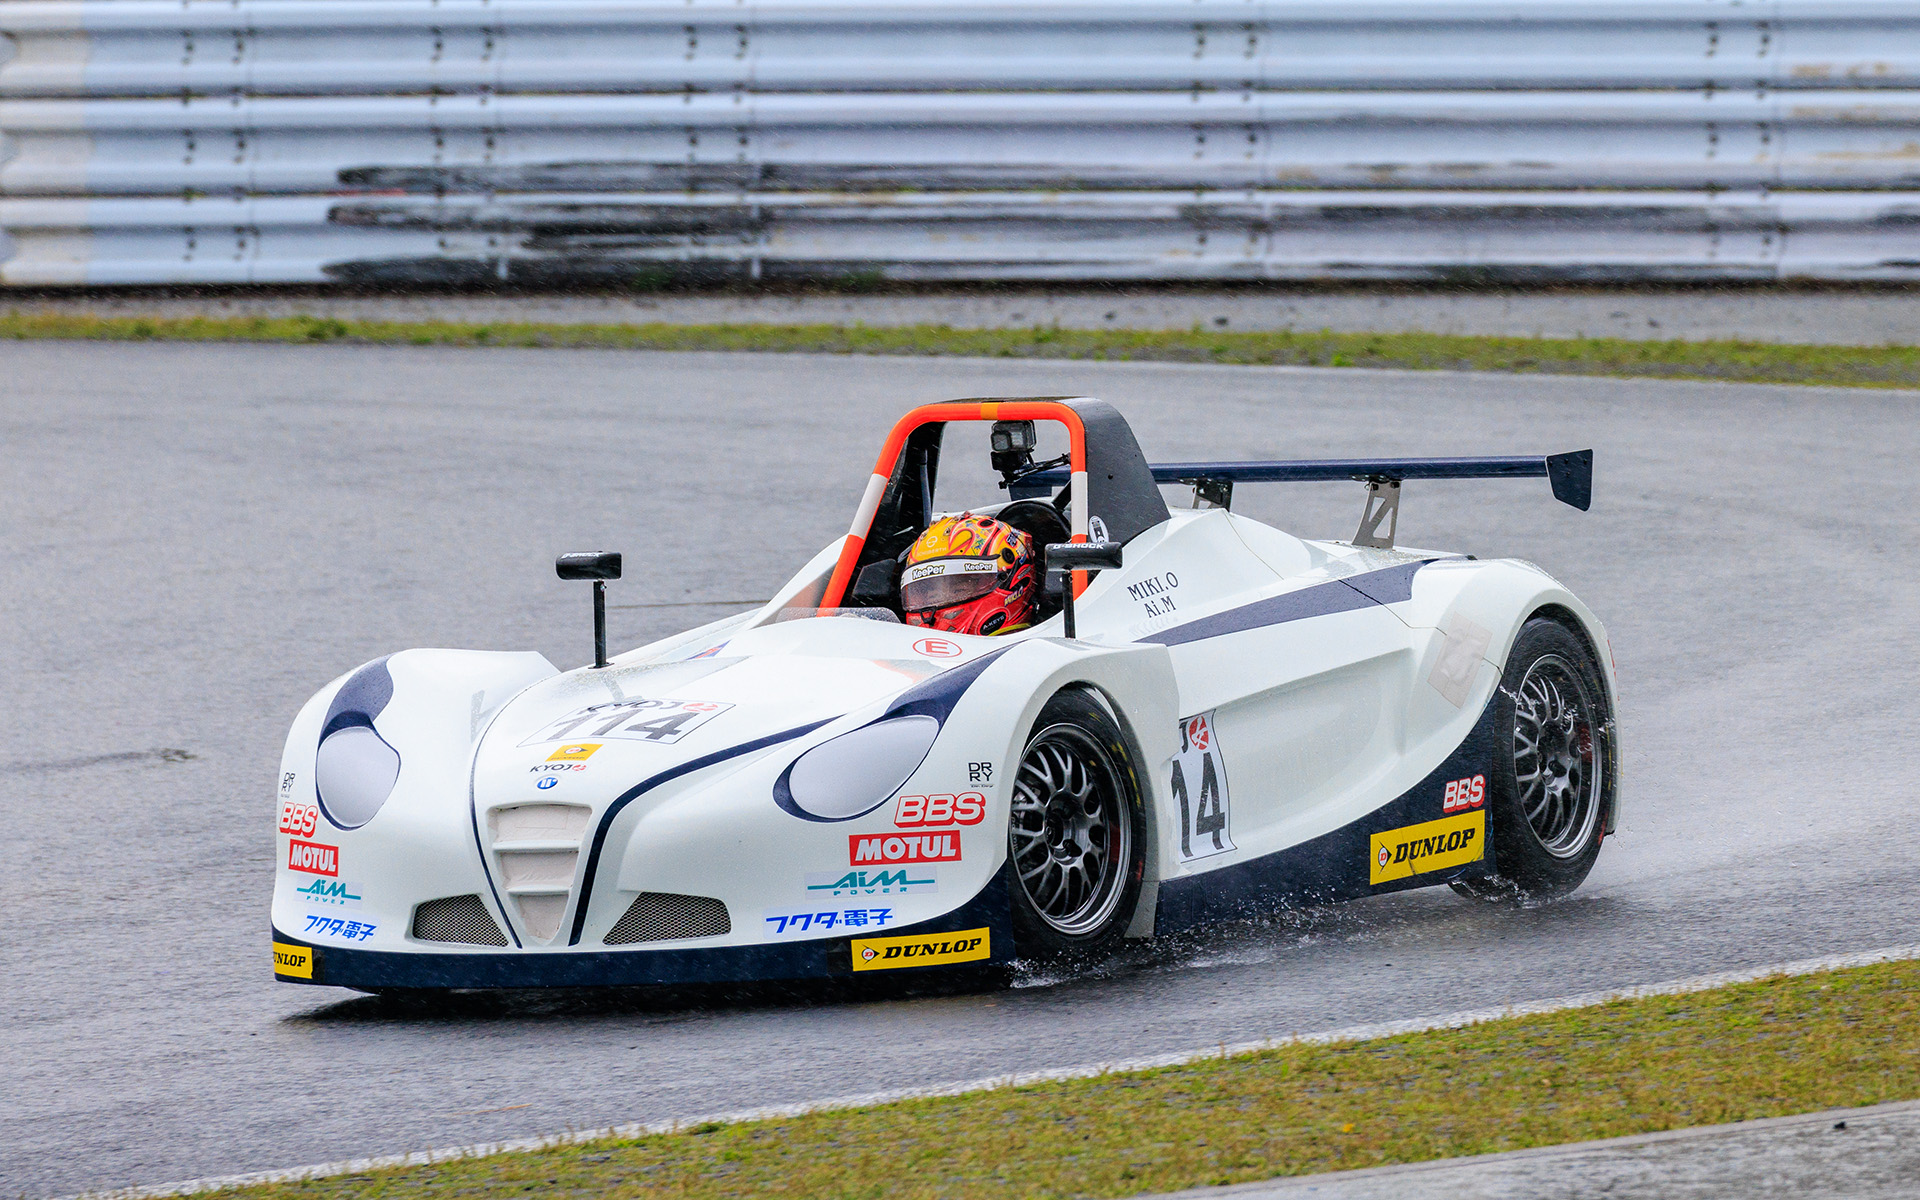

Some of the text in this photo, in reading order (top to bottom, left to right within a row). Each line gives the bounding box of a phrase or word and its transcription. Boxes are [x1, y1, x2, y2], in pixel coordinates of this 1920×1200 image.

[912, 565, 945, 579] KeePer
[964, 563, 993, 571] KeePer
[1127, 572, 1178, 601] MIKI.O
[925, 640, 950, 654] E
[547, 709, 700, 740] 114
[1443, 774, 1486, 813] BBS
[279, 802, 318, 838] BBS
[894, 792, 986, 828] BBS
[290, 844, 337, 872] MOTUL
[855, 835, 957, 861] MOTUL
[1393, 828, 1475, 864] DUNLOP
[833, 886, 908, 896] POWER
[304, 915, 377, 941] フクダ電子
[766, 908, 893, 933] フクダ電子
[882, 938, 982, 959] DUNLOP
